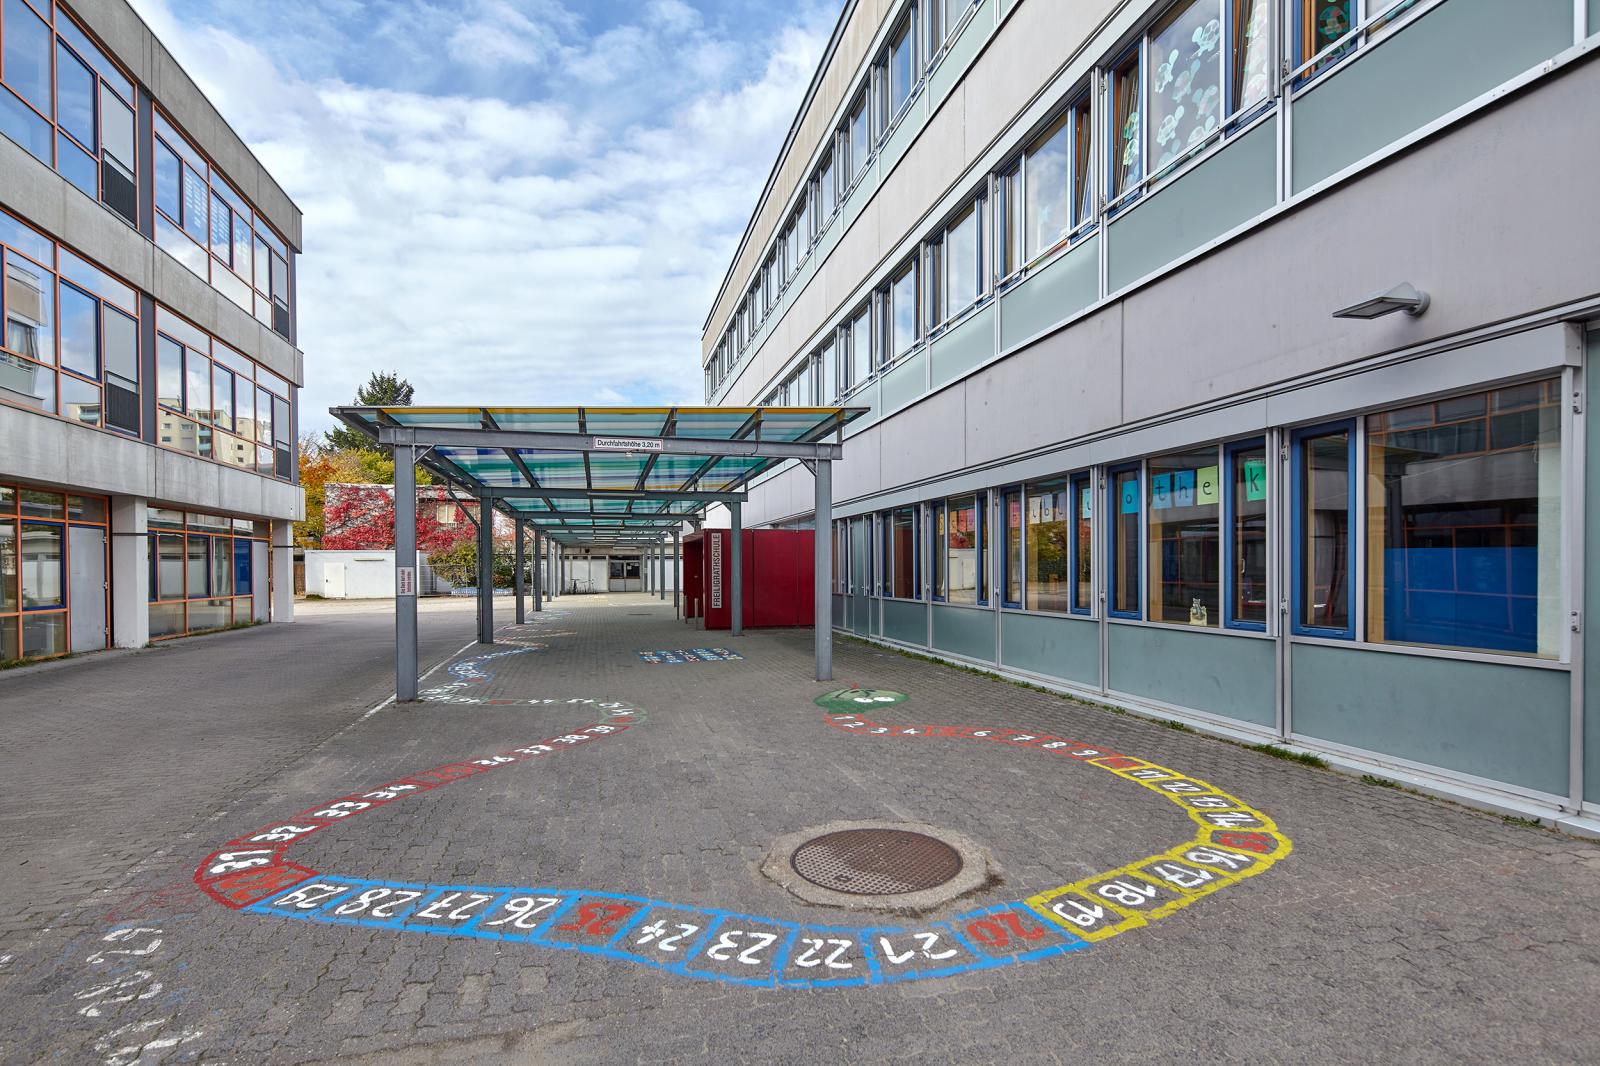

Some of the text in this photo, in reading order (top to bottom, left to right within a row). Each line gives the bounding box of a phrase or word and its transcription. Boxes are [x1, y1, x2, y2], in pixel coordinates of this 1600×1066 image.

[553, 735, 589, 743] 38
[473, 756, 514, 765] 36
[1133, 770, 1168, 778] 11
[1162, 782, 1200, 792] 12
[314, 802, 370, 817] 33
[1190, 797, 1229, 807] 13
[1207, 812, 1255, 827] 14
[251, 826, 317, 841] 32
[210, 850, 272, 873] 31
[1185, 847, 1250, 869] 16
[1154, 864, 1213, 887] 17
[274, 885, 349, 909] 29
[335, 888, 421, 917] 28
[1099, 881, 1156, 905] 18
[418, 892, 493, 919] 27
[488, 897, 562, 928] 26
[1053, 900, 1103, 926] 19
[637, 919, 699, 951] 24
[967, 913, 1045, 947] 20
[707, 930, 778, 964] 23
[797, 939, 852, 968] 22
[880, 932, 957, 961] 21
